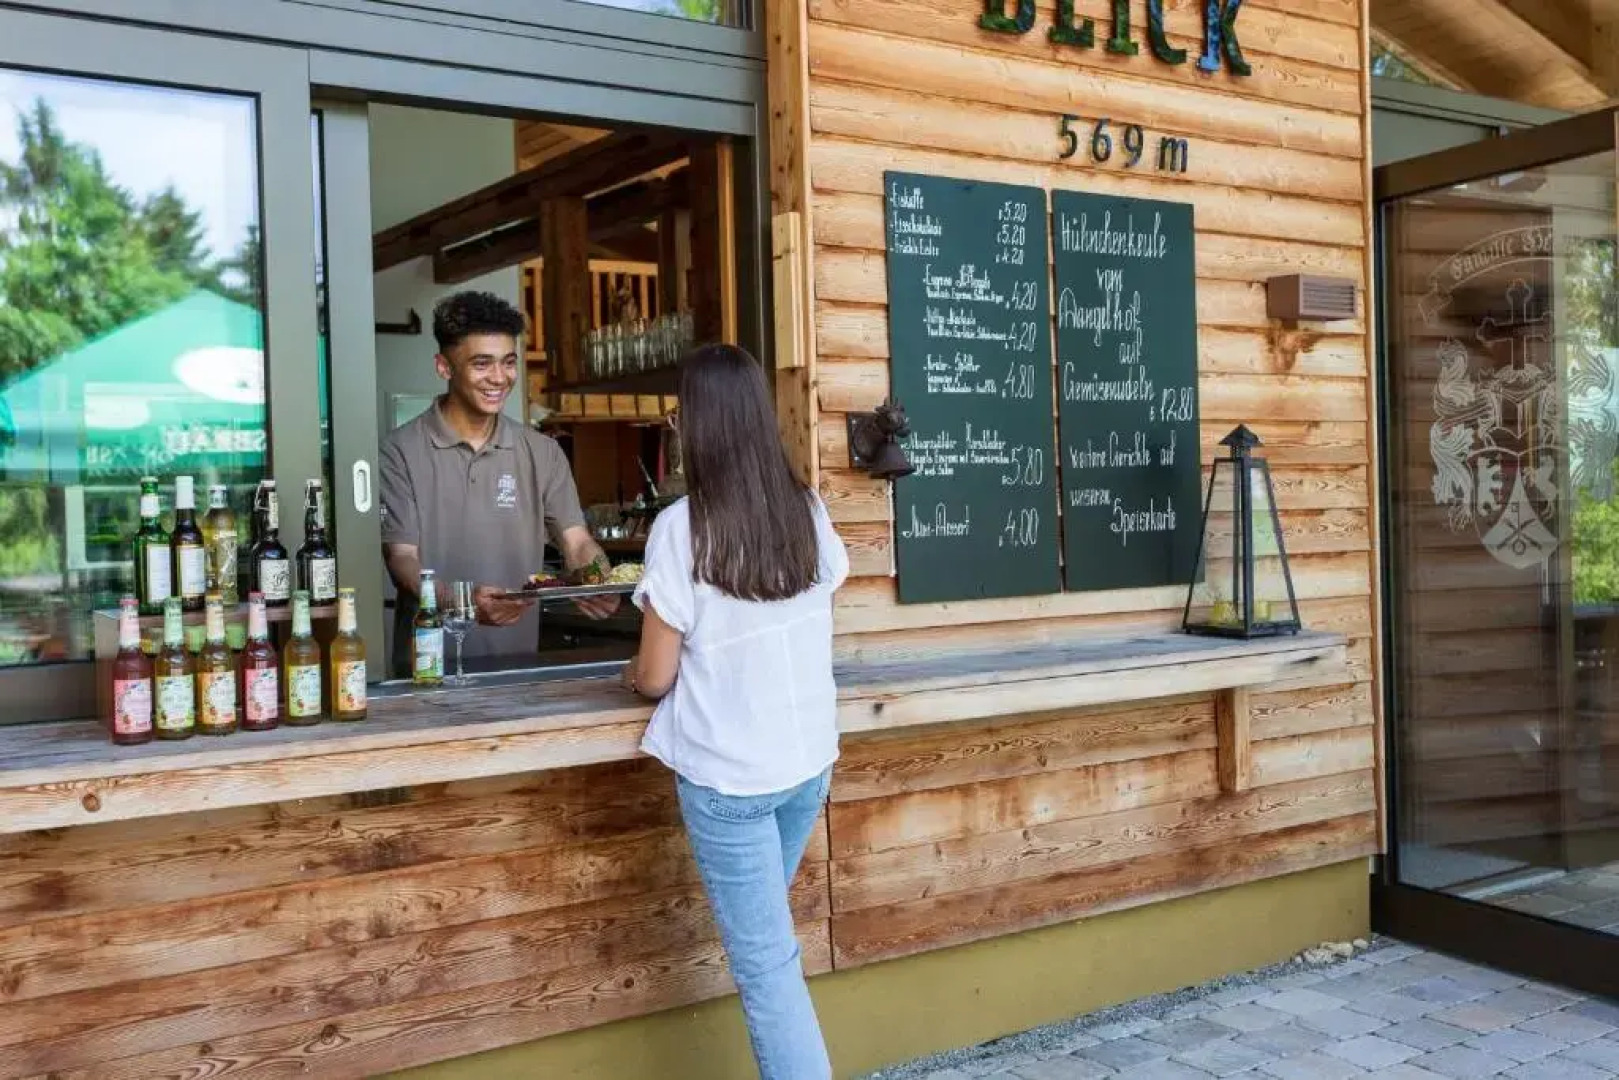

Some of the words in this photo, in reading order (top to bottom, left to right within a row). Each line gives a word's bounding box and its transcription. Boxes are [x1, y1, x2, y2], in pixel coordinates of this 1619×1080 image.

[1058, 114, 1144, 169] 569
[1158, 135, 1189, 173] m
[1096, 268, 1123, 292] vom
[1118, 326, 1143, 365] auf
[1109, 431, 1151, 467] Gerichte
[1160, 429, 1177, 466] auf
[1110, 497, 1177, 547] Speisekarte
